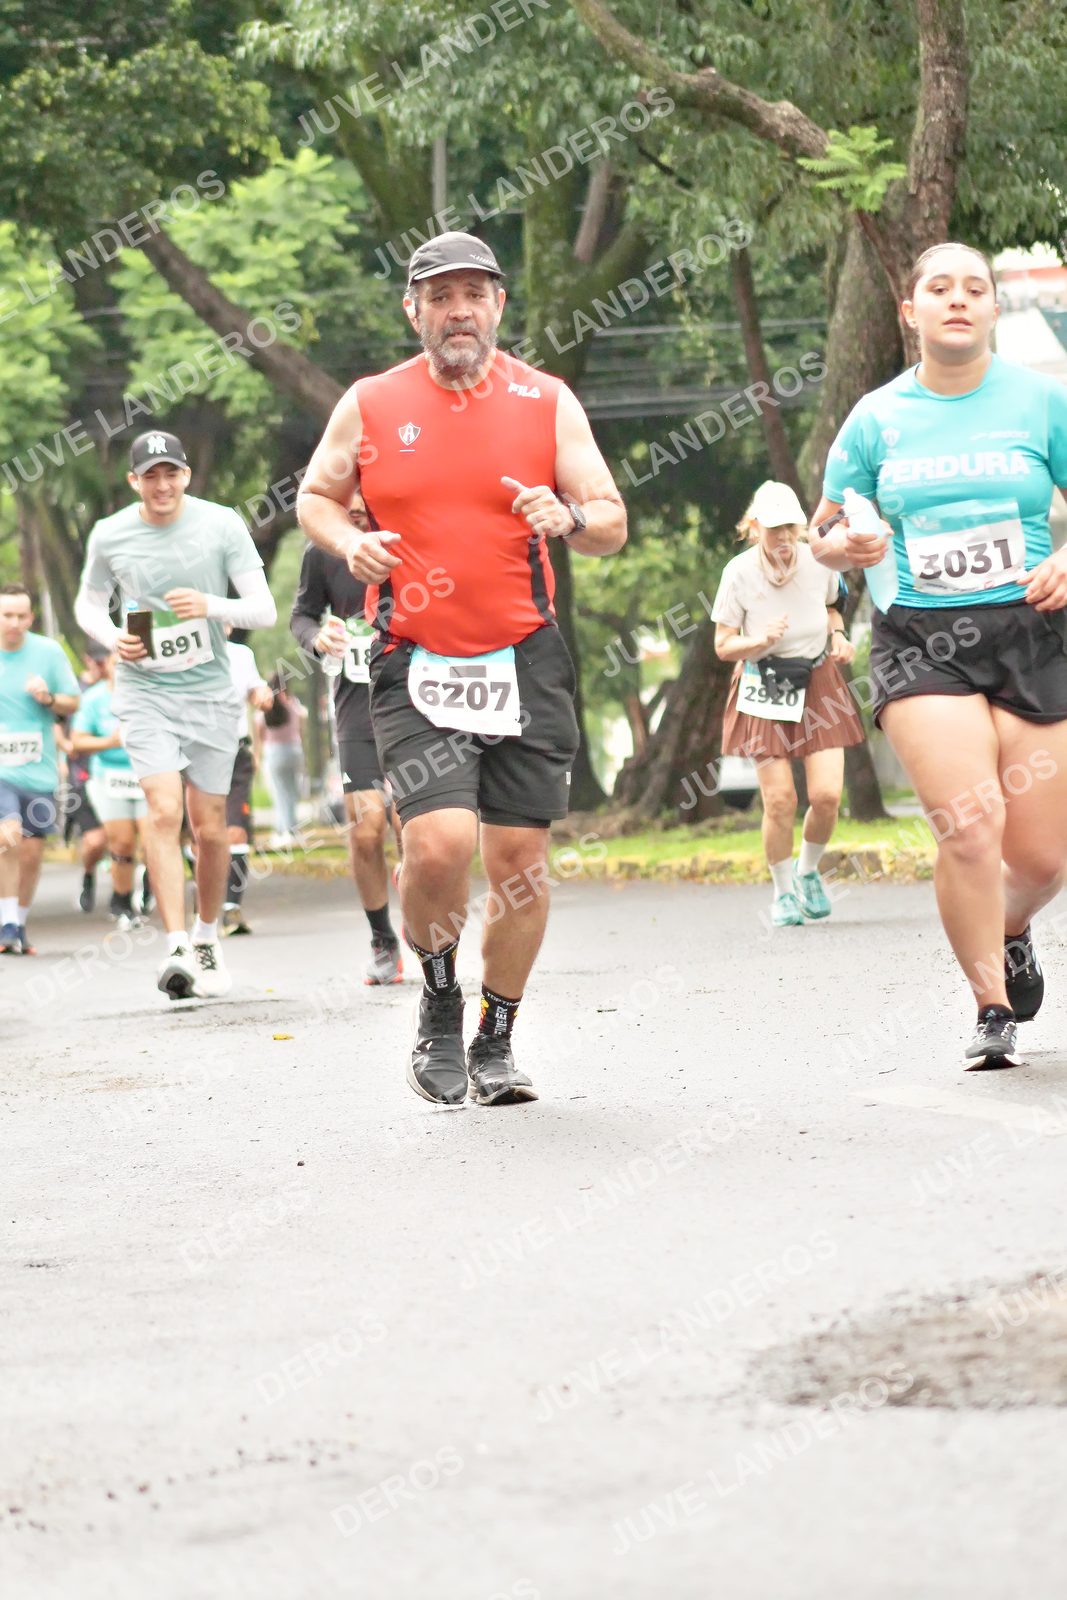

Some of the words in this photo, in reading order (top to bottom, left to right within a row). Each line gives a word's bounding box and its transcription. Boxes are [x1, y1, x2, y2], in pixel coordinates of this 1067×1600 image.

[508, 382, 541, 399] FILA
[877, 451, 1031, 485] PERDURA
[919, 538, 1013, 580] 3031
[157, 630, 203, 658] 891
[417, 679, 512, 712] 6207
